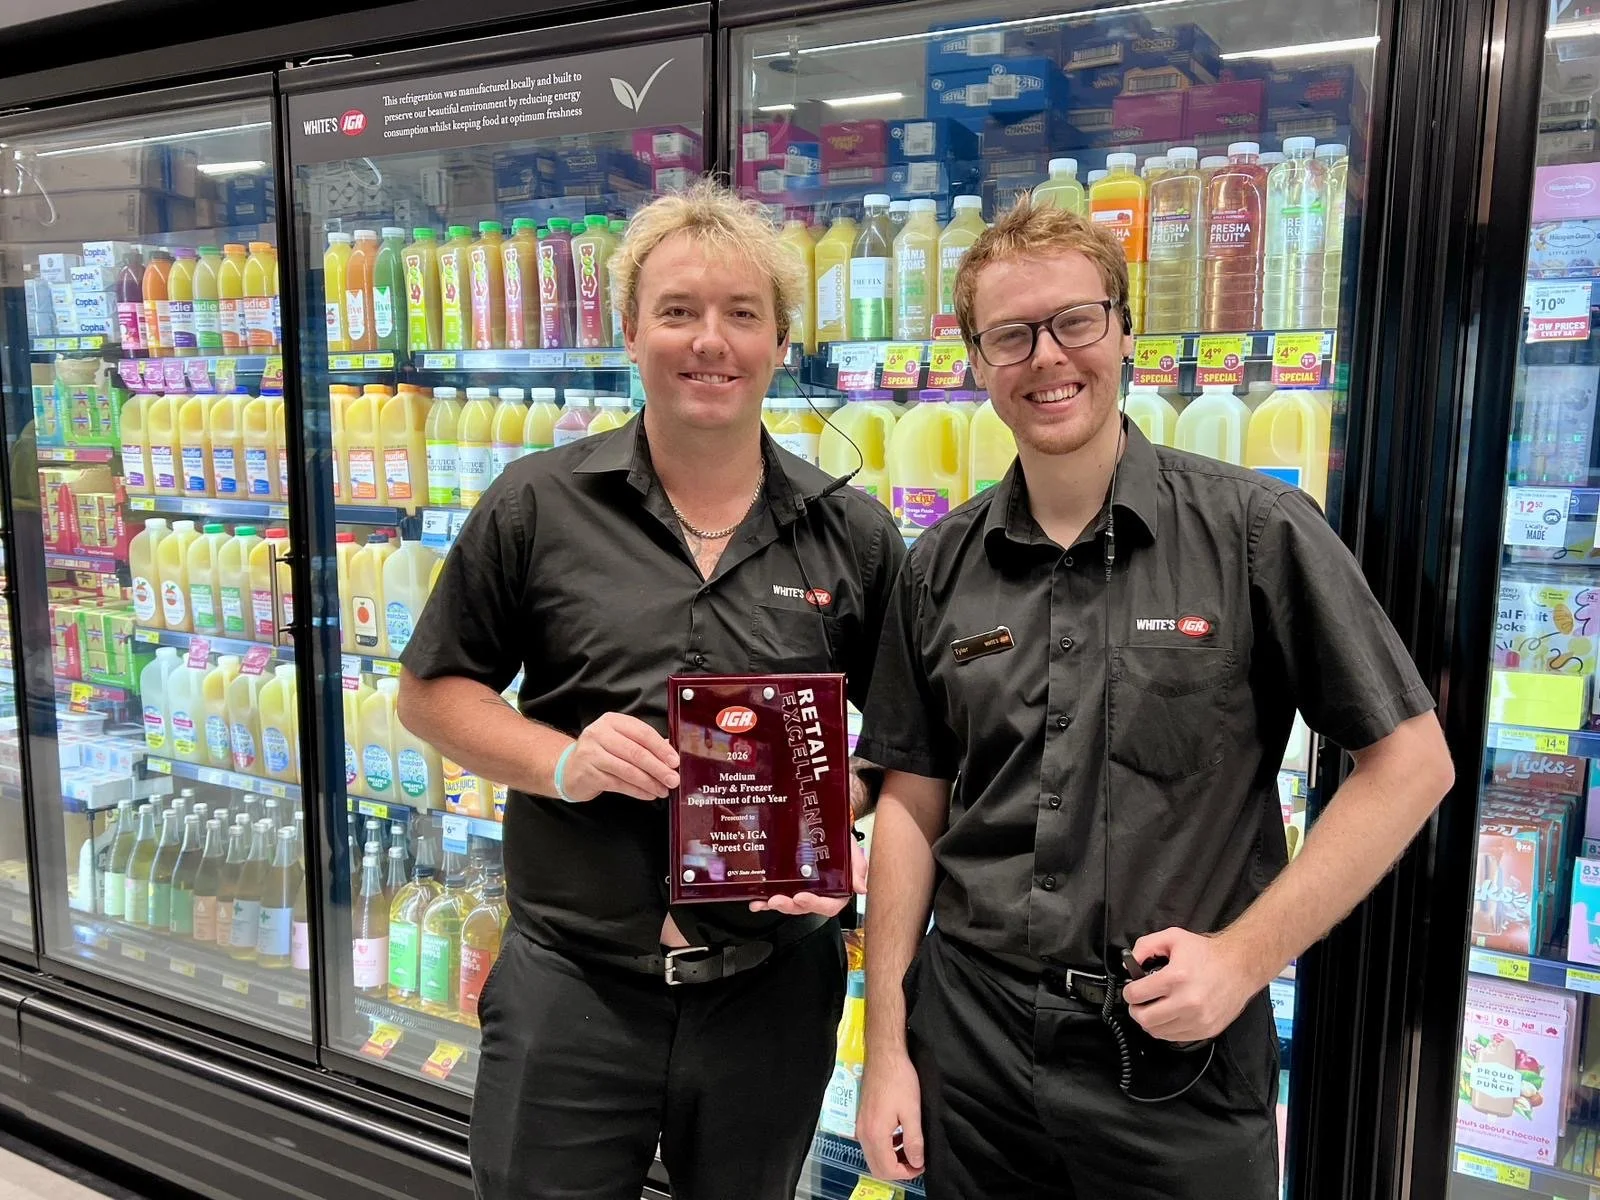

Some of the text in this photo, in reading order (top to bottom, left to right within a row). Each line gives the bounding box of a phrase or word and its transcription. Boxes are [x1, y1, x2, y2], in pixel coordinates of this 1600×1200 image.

[382, 71, 582, 106] This refrigeration was manufactured locally and built to
[384, 90, 581, 126] preserve our beautiful environment by reducing energy
[303, 113, 365, 136] WHITE'S IGA
[383, 106, 583, 138] consumption whilst keeping food at optimum freshness
[1152, 223, 1190, 234] PRESHA
[1211, 223, 1251, 233] PRESHA
[1152, 232, 1180, 243] FRUIT
[1210, 233, 1241, 243] FRUIT
[83, 248, 106, 258] Copha
[942, 248, 961, 258] EMM
[71, 272, 94, 281] Copha
[75, 298, 98, 308] Copha
[80, 323, 105, 333] Copha
[1534, 321, 1586, 331] LOW PRICES
[888, 376, 914, 385] SPECIAL
[934, 376, 960, 385] SPECIAL
[1140, 373, 1173, 383] SPECIAL
[1203, 372, 1237, 382] SPECIAL
[1279, 372, 1315, 382] SPECIAL
[1526, 529, 1546, 540] MADE
[772, 584, 805, 599] WHITE'S
[1515, 610, 1548, 622] Fruit
[1136, 618, 1176, 631] WHITE'S
[1181, 618, 1206, 632] IGA
[720, 710, 754, 727] IGA
[797, 688, 830, 781] RETAIL
[726, 751, 749, 761] 2026
[1506, 753, 1565, 779] Licks
[719, 772, 756, 781] Medium
[782, 691, 830, 860] EXCELLENCE
[702, 784, 773, 796] Dairy & Freezer
[687, 794, 788, 807] Department of the Year
[720, 814, 748, 822] Presented
[709, 830, 768, 841] White's IGA
[711, 842, 765, 853] Forest Glen
[1496, 1017, 1510, 1027] 98
[1477, 1067, 1514, 1081] PROUD
[1476, 1080, 1513, 1093] PUNCH
[1478, 1122, 1505, 1135] about
[1506, 1126, 1550, 1146] chocolate
